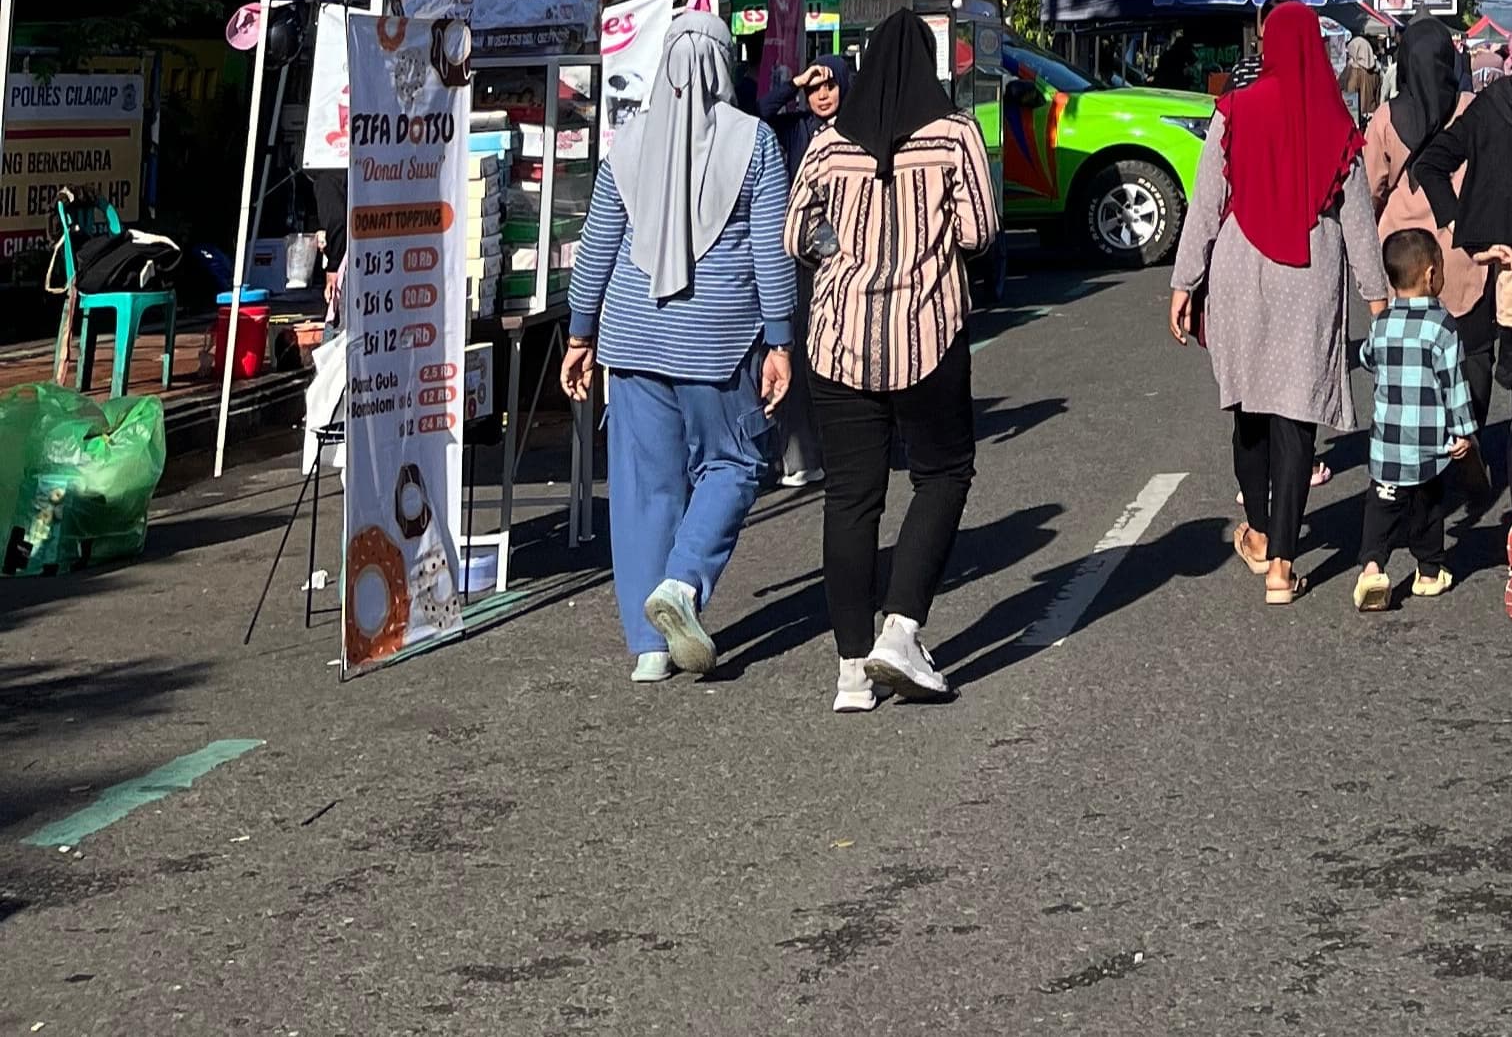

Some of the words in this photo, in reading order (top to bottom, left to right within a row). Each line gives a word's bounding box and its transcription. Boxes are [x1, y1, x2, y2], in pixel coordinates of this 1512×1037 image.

[11, 85, 61, 107] POLRES
[66, 85, 119, 106] CILACAP
[351, 113, 391, 145] FIFA
[396, 112, 455, 145] DOTSU
[28, 149, 112, 174] BERKENDARA
[355, 211, 393, 232] DONAT
[394, 208, 442, 229] TOPPING
[364, 251, 382, 276] Isi
[384, 250, 394, 274] 3
[407, 252, 418, 268] 10
[419, 251, 433, 267] Rb
[363, 291, 380, 316] Isi
[384, 289, 393, 313] 6
[405, 289, 417, 305] 20
[419, 288, 431, 303] Rb
[363, 330, 380, 356] Isi
[384, 328, 397, 352] 12
[406, 391, 412, 407] 6
[423, 392, 434, 403] 12
[437, 389, 452, 401] Rb
[406, 419, 415, 436] 12
[421, 419, 434, 431] 24
